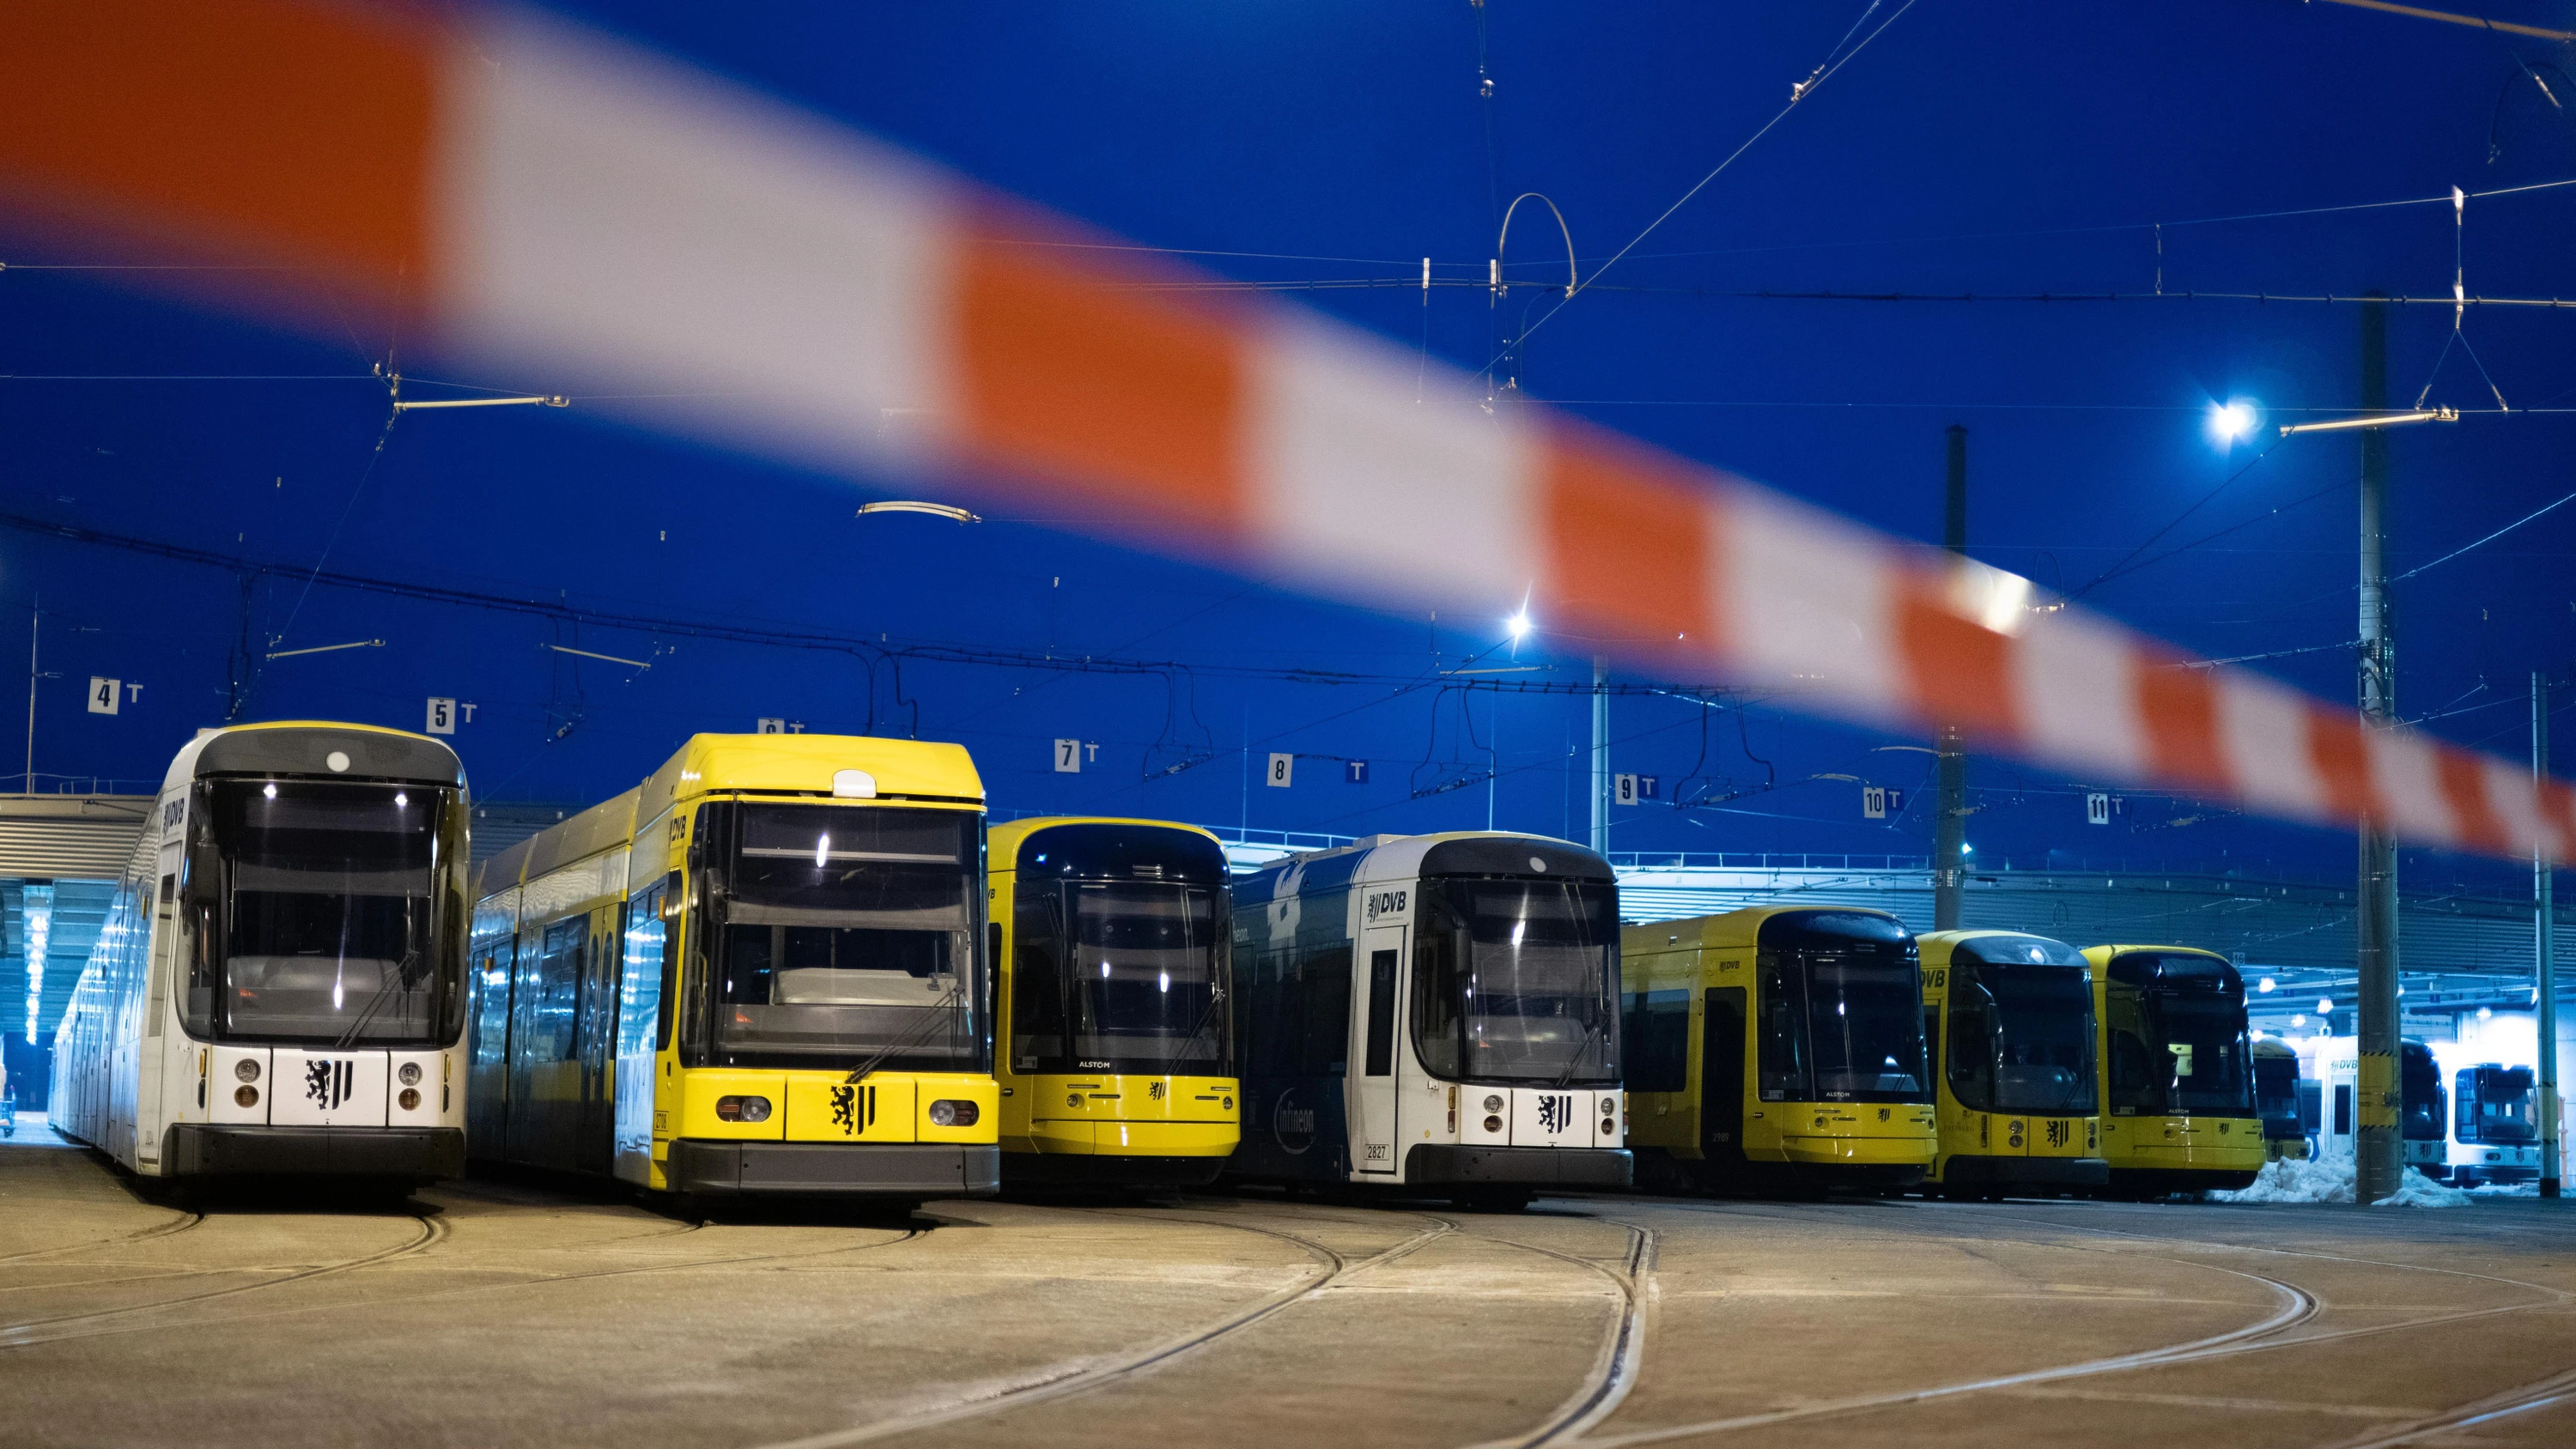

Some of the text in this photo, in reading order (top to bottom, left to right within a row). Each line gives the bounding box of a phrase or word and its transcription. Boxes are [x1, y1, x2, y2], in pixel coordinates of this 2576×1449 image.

[97, 684, 111, 707] 4
[126, 683, 143, 703] T
[435, 704, 447, 727] 5
[461, 703, 477, 723] T
[1061, 744, 1072, 766] 7
[1084, 743, 1099, 762] T
[1275, 760, 1285, 780] 8
[1351, 762, 1364, 780] T
[1622, 779, 1631, 799] 9
[1642, 778, 1656, 795] T
[1867, 792, 1881, 812] 10
[1888, 791, 1900, 808] T
[2091, 798, 2105, 819] 11
[2111, 797, 2123, 815] T
[169, 797, 185, 827] DVB
[671, 815, 686, 841] DVB
[1381, 891, 1406, 913] DVB
[1726, 961, 1741, 969] DVB
[2339, 1059, 2358, 1069] DVB
[1368, 1146, 1386, 1159] 2827
